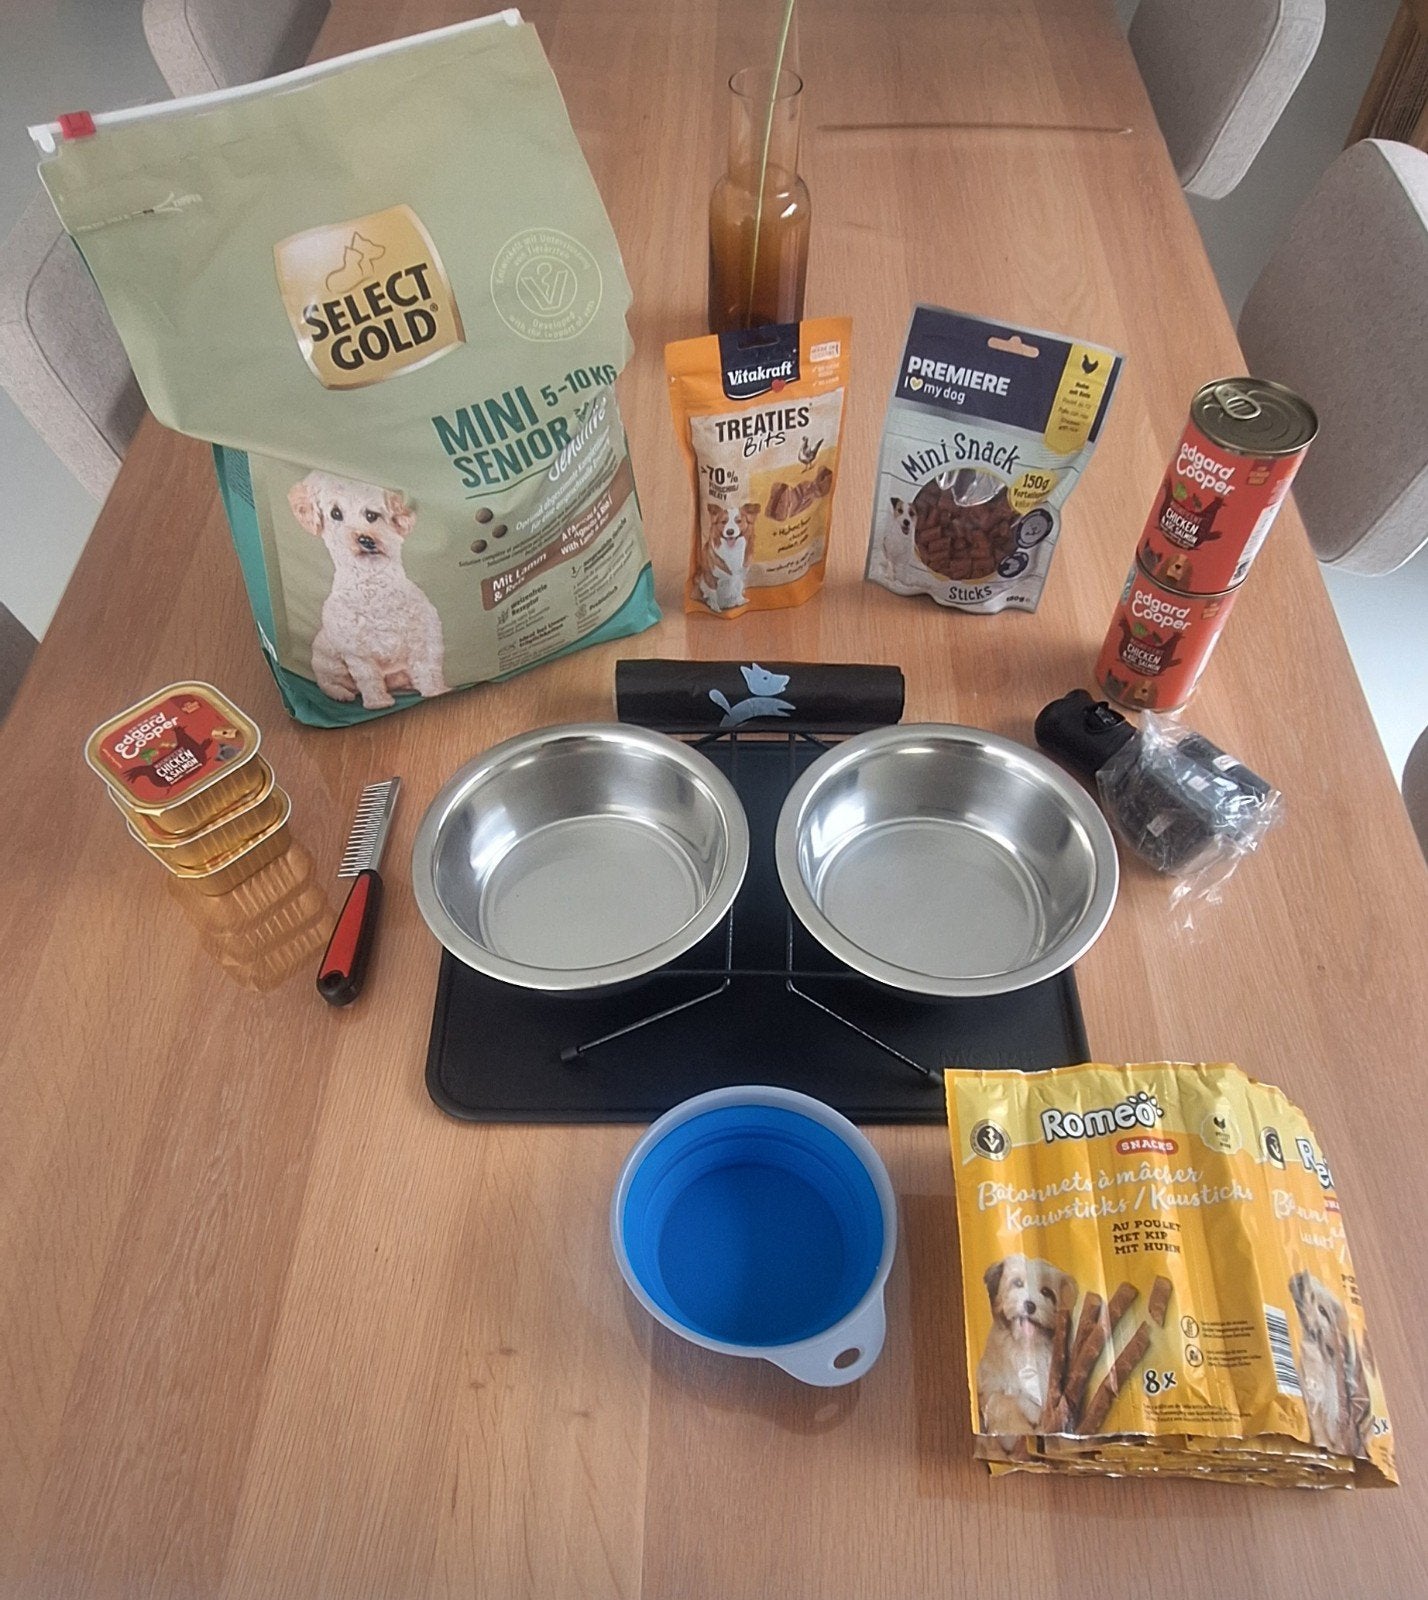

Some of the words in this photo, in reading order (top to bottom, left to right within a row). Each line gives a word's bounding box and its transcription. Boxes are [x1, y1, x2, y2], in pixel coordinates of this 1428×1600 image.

[303, 263, 432, 342] SELECT
[727, 360, 794, 387] Vitakraft
[907, 355, 1011, 397] PREMIERE
[923, 382, 941, 399] my
[943, 386, 966, 405] dog
[432, 386, 539, 456] MINI
[589, 364, 617, 388] KG
[715, 406, 810, 443] TREATIES
[453, 416, 572, 489] SENIOR
[743, 431, 786, 458] Bits
[901, 438, 951, 482] Mini
[953, 432, 1021, 475] Snack
[1176, 453, 1236, 496] Cooper
[1181, 442, 1236, 480] edgard
[1022, 473, 1051, 491] 150g
[1165, 507, 1199, 535] CHICKEN
[561, 542, 580, 556] With
[492, 575, 513, 592] Mit
[515, 553, 548, 579] Lamm
[494, 591, 503, 603] &
[949, 585, 993, 602] Sticks
[1135, 590, 1191, 619] edgard
[1131, 599, 1192, 630] Cooper
[1127, 643, 1162, 665] CHICKEN
[114, 712, 167, 753] edgard
[121, 716, 179, 760] Cooper
[156, 749, 195, 778] CHICKEN
[1041, 1093, 1162, 1143] Romeo
[1121, 1138, 1175, 1152] SNACKS
[1097, 1168, 1115, 1188] à
[1116, 1160, 1204, 1186] mâcher
[1005, 1196, 1127, 1232] Kauwsticks
[1150, 1178, 1254, 1211] Kausticks
[1112, 1221, 1130, 1232] AU
[1134, 1219, 1182, 1232] POULET
[1113, 1232, 1140, 1243] MET
[1144, 1230, 1169, 1241] KIP
[1114, 1243, 1142, 1255] MIT
[1144, 1242, 1182, 1255] HUHN
